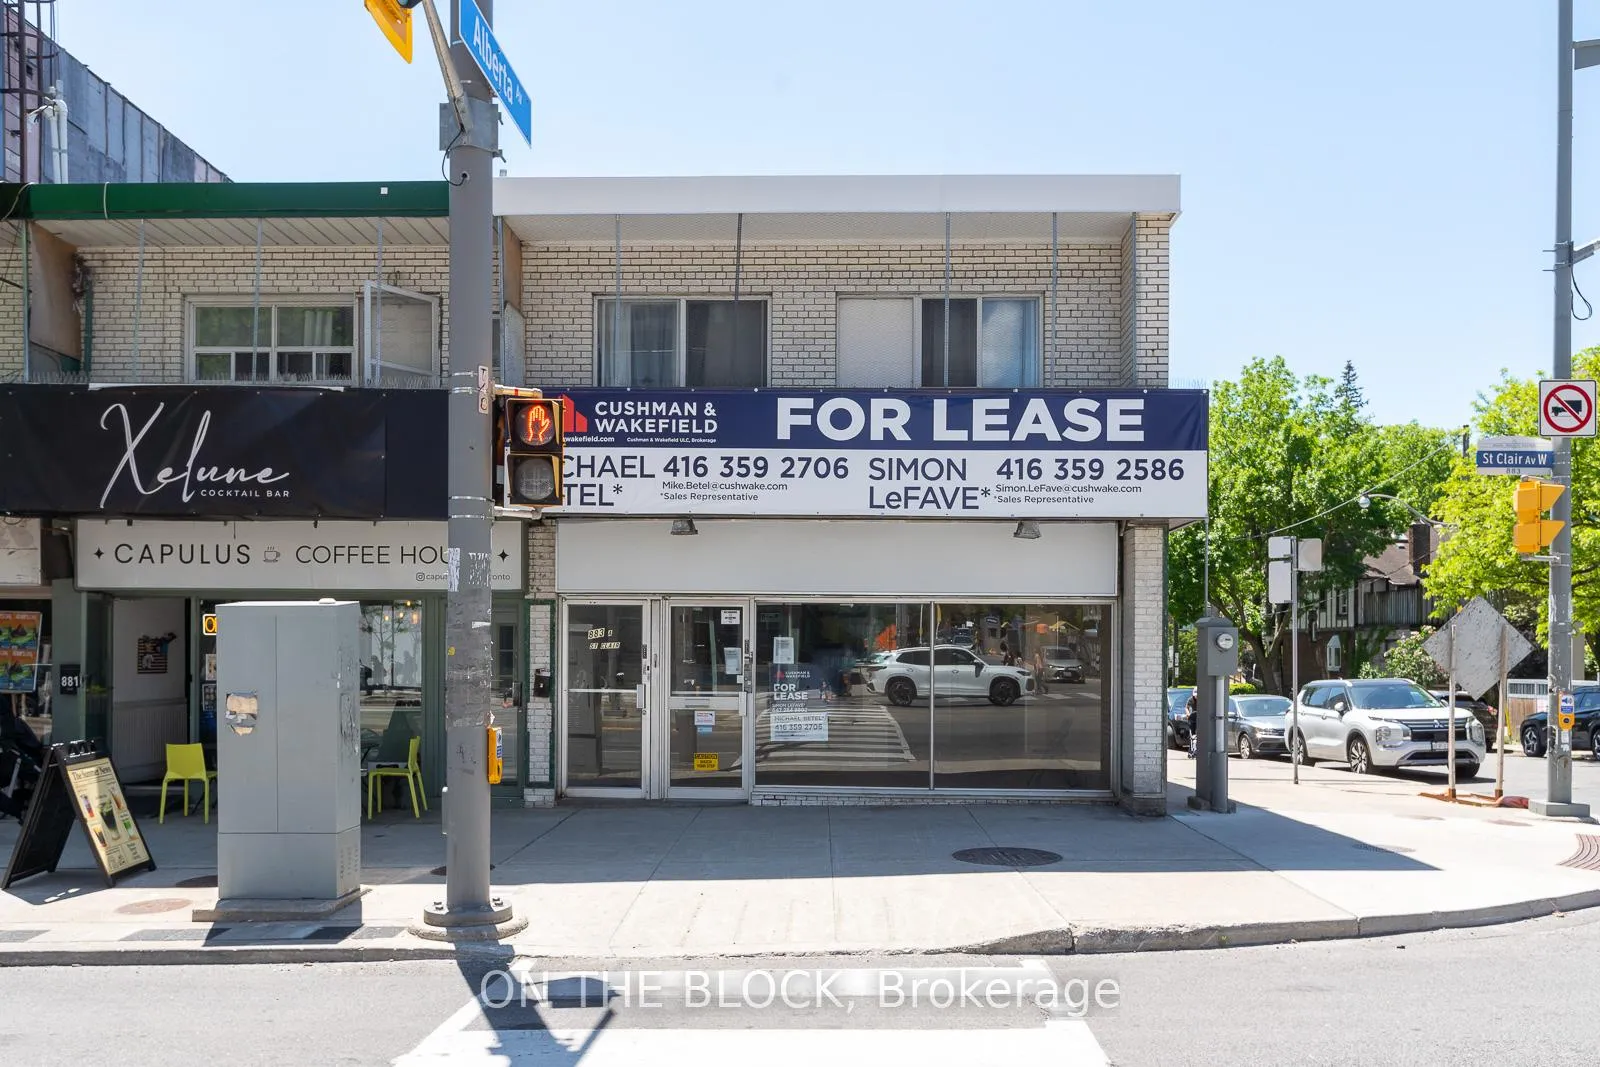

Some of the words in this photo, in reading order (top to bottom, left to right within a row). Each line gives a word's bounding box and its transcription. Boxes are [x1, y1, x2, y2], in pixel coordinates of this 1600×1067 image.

[473, 15, 514, 106] Alberta
[594, 401, 697, 417] CUSHMAN
[703, 402, 717, 417] &
[594, 418, 719, 434] WAKEFIELD
[776, 397, 912, 442] FOR
[932, 398, 1146, 443] LEASE
[563, 435, 615, 443] wakefield.com
[100, 401, 291, 509] Xelune
[1482, 452, 1494, 465] St
[1496, 452, 1523, 465] Clair
[1524, 456, 1536, 465] Av
[1537, 453, 1548, 466] W
[563, 455, 656, 479] CHAEL
[662, 455, 709, 478] 416
[719, 456, 769, 479] 359
[780, 456, 849, 480] 2706
[868, 457, 967, 481] SIMON
[996, 458, 1043, 481] 416
[1053, 458, 1105, 481] 359
[1116, 458, 1185, 481] 2586
[662, 481, 788, 491] Mike.Betel@cushwake.com
[995, 484, 1142, 494] Simon.LeFave@cushwake.com
[200, 489, 262, 498] COCKTAIL
[265, 489, 291, 498] BAR
[563, 483, 623, 507] TEL
[690, 492, 759, 502] Representative
[1024, 495, 1095, 505] Representative
[113, 543, 252, 566] CAPULUS
[295, 545, 391, 566] COFFEE
[400, 545, 448, 565] HOU
[588, 628, 605, 639] 883
[61, 675, 79, 687] 881
[774, 683, 796, 691] FOR
[774, 692, 808, 700] LEASE
